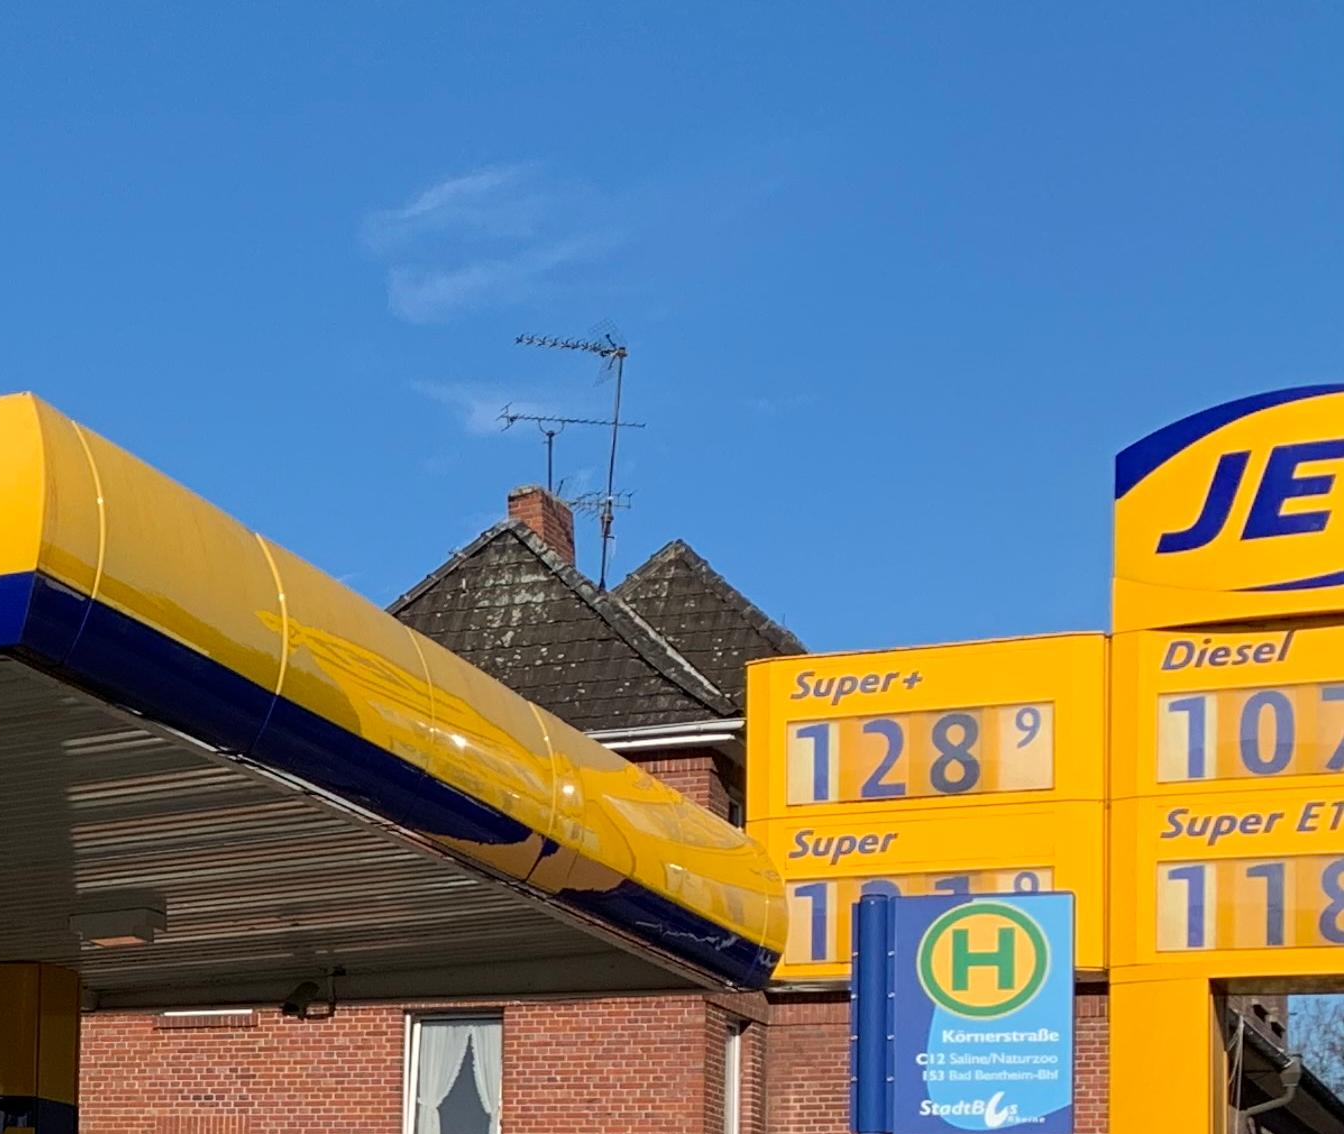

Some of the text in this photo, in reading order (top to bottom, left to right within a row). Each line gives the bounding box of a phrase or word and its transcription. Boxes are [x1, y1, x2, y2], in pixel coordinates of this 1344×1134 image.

[1155, 438, 1344, 555] JE
[1161, 629, 1295, 671] Diesel
[790, 671, 923, 705] Super+
[1160, 807, 1285, 847] Super
[788, 830, 899, 866] Super
[942, 1028, 1060, 1044] Körnerstraße
[916, 1053, 1058, 1066] C12 Saline/Naturzoo
[949, 1070, 972, 1081] Bad
